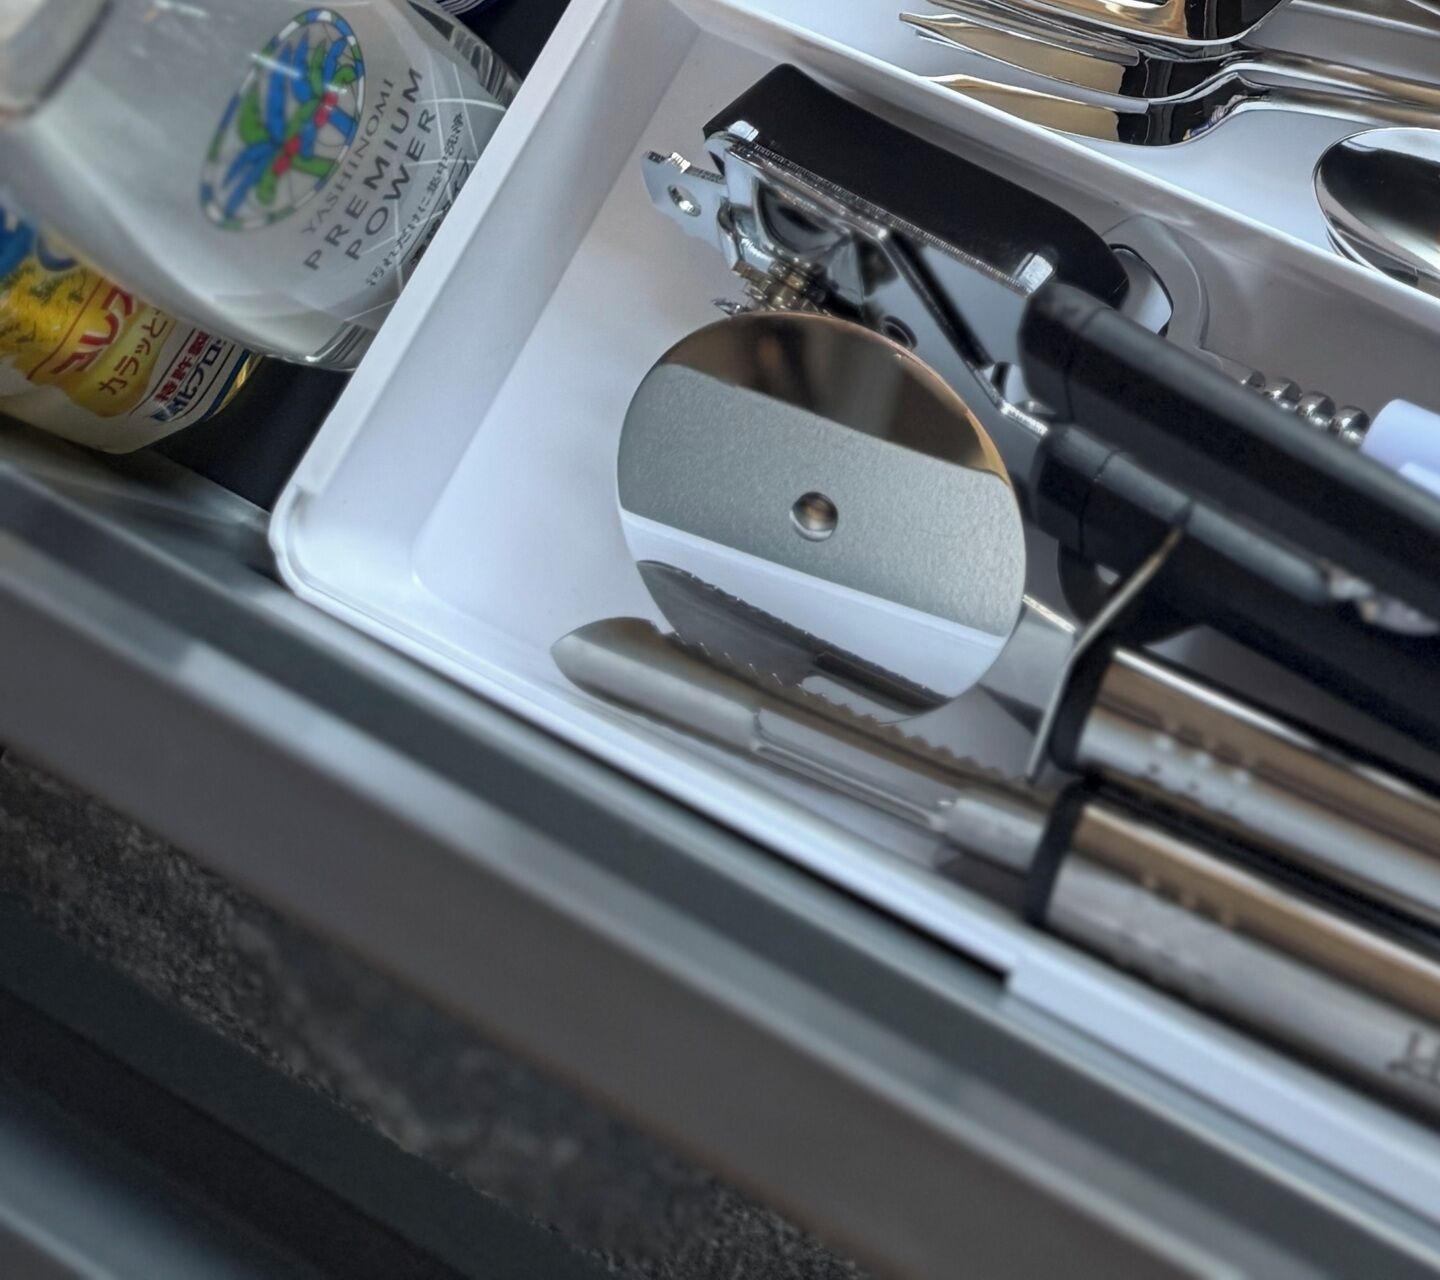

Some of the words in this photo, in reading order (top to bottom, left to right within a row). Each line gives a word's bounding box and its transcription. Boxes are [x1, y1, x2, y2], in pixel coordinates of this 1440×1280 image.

[300, 78, 395, 236] YASHINOMI
[303, 67, 423, 271] PREMIUM
[344, 108, 437, 262] POWER
